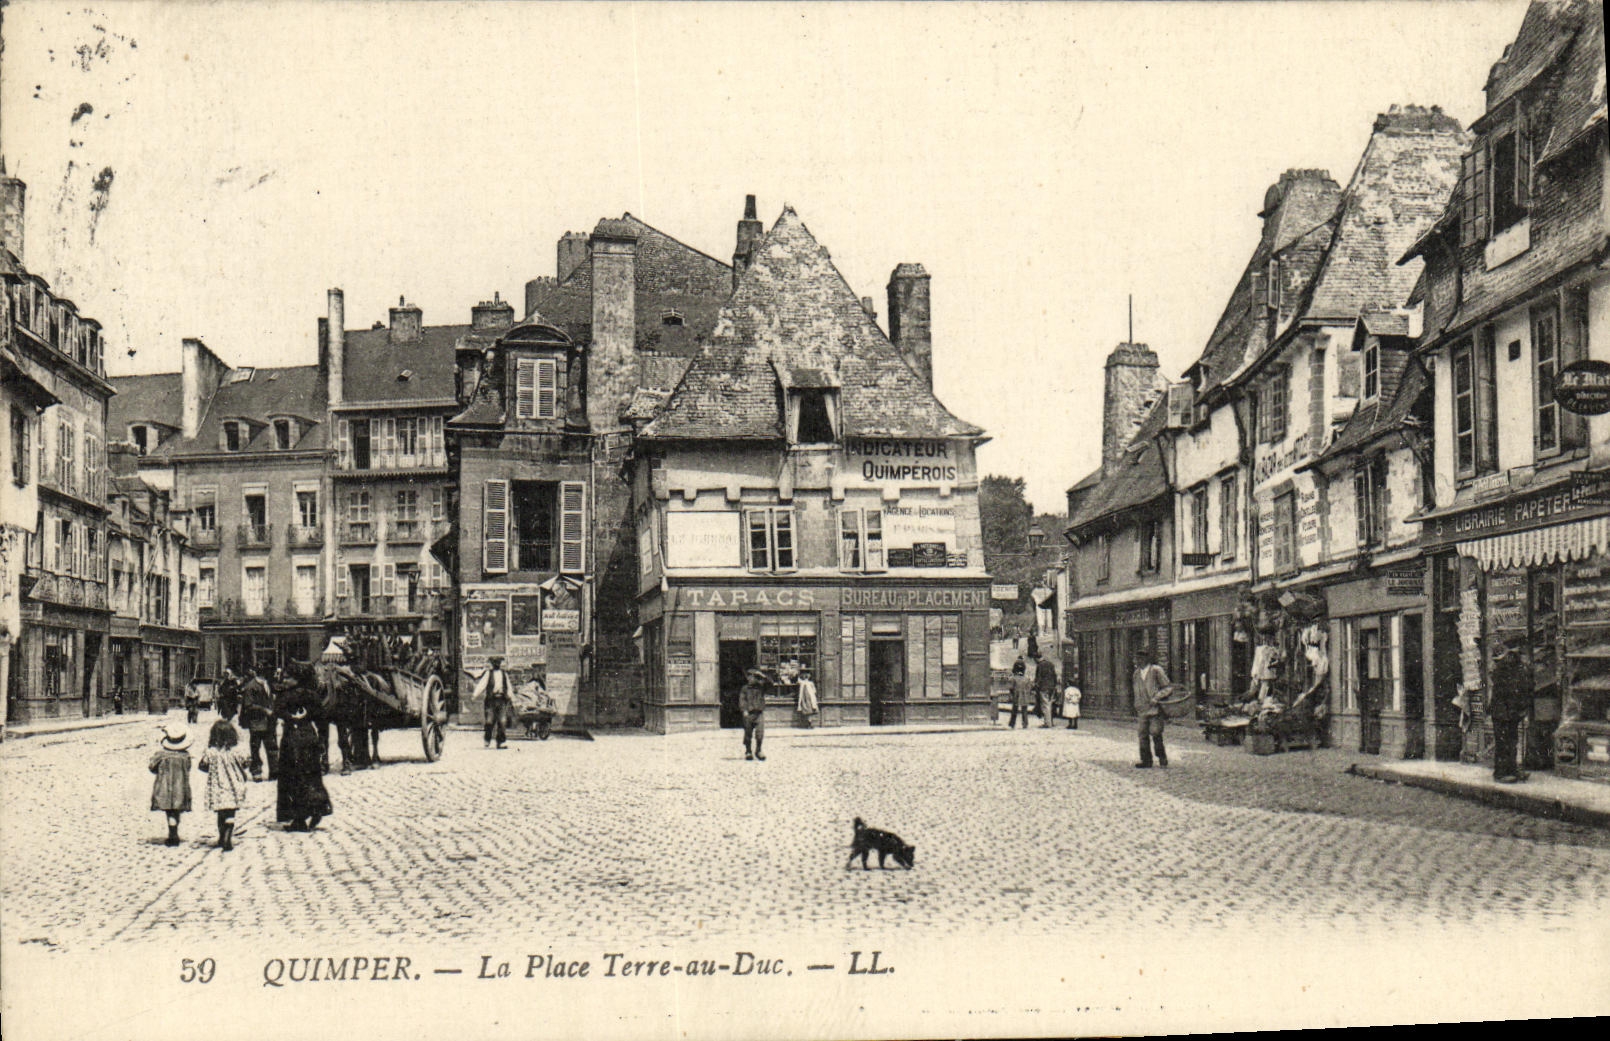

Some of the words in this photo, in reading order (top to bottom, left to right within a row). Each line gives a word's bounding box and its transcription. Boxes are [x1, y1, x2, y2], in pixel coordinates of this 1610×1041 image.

[846, 441, 948, 458] INDICATEUR
[886, 505, 912, 515] AGENCE
[919, 505, 954, 517] LOCATIONS
[1455, 507, 1506, 533] LIBRAIRIE
[1514, 492, 1585, 522] PAPETER
[842, 588, 897, 606] BUREAU
[907, 590, 987, 606] PLACEMENT
